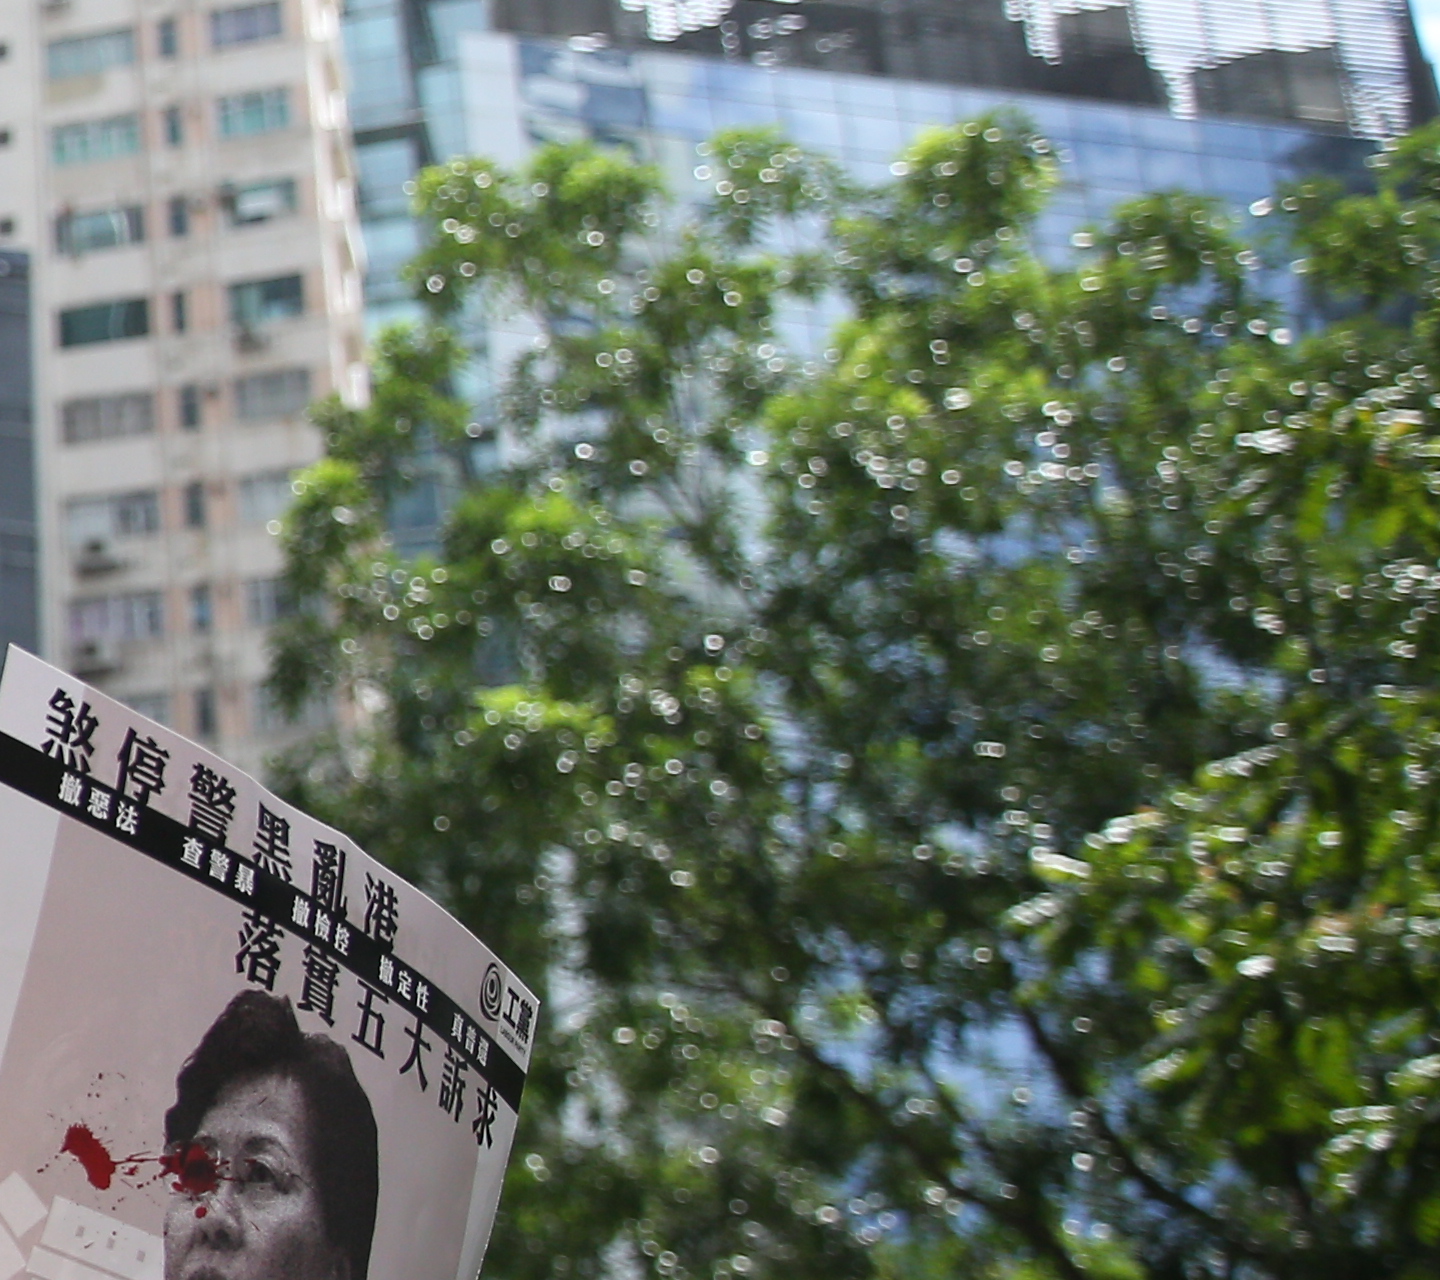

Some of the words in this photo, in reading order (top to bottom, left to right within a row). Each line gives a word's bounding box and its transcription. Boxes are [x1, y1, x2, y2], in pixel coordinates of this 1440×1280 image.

[41, 687, 399, 954] 煞停警黑亂港
[180, 836, 255, 896] 查警暴
[236, 909, 498, 1150] 落實五大訴求
